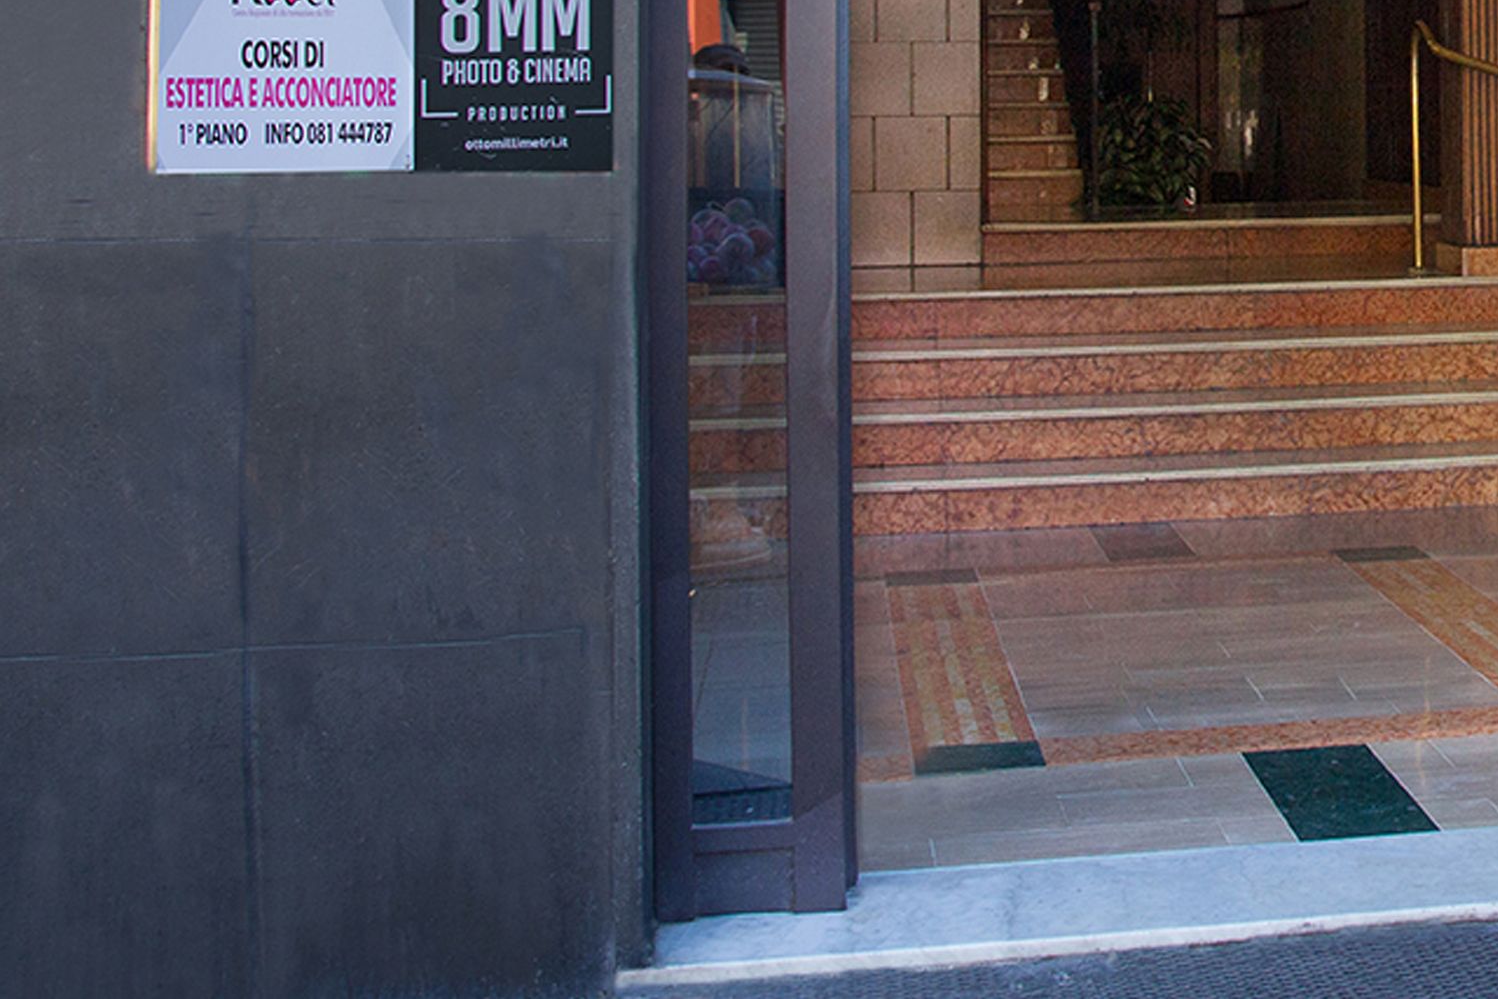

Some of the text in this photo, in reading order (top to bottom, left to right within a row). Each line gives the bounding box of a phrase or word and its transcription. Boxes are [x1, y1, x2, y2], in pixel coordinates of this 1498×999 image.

[242, 40, 325, 68] CORSI DI
[442, 57, 592, 86] PHOTO & CINEMA
[166, 77, 398, 108] ESTETICA E ACCONCIATORE
[467, 105, 567, 122] PRODUCTION
[196, 123, 248, 146] PIANO
[265, 123, 304, 145] INFO
[307, 123, 334, 145] 081
[338, 122, 394, 145] 444787
[465, 136, 569, 151] ottomillimetri.it
